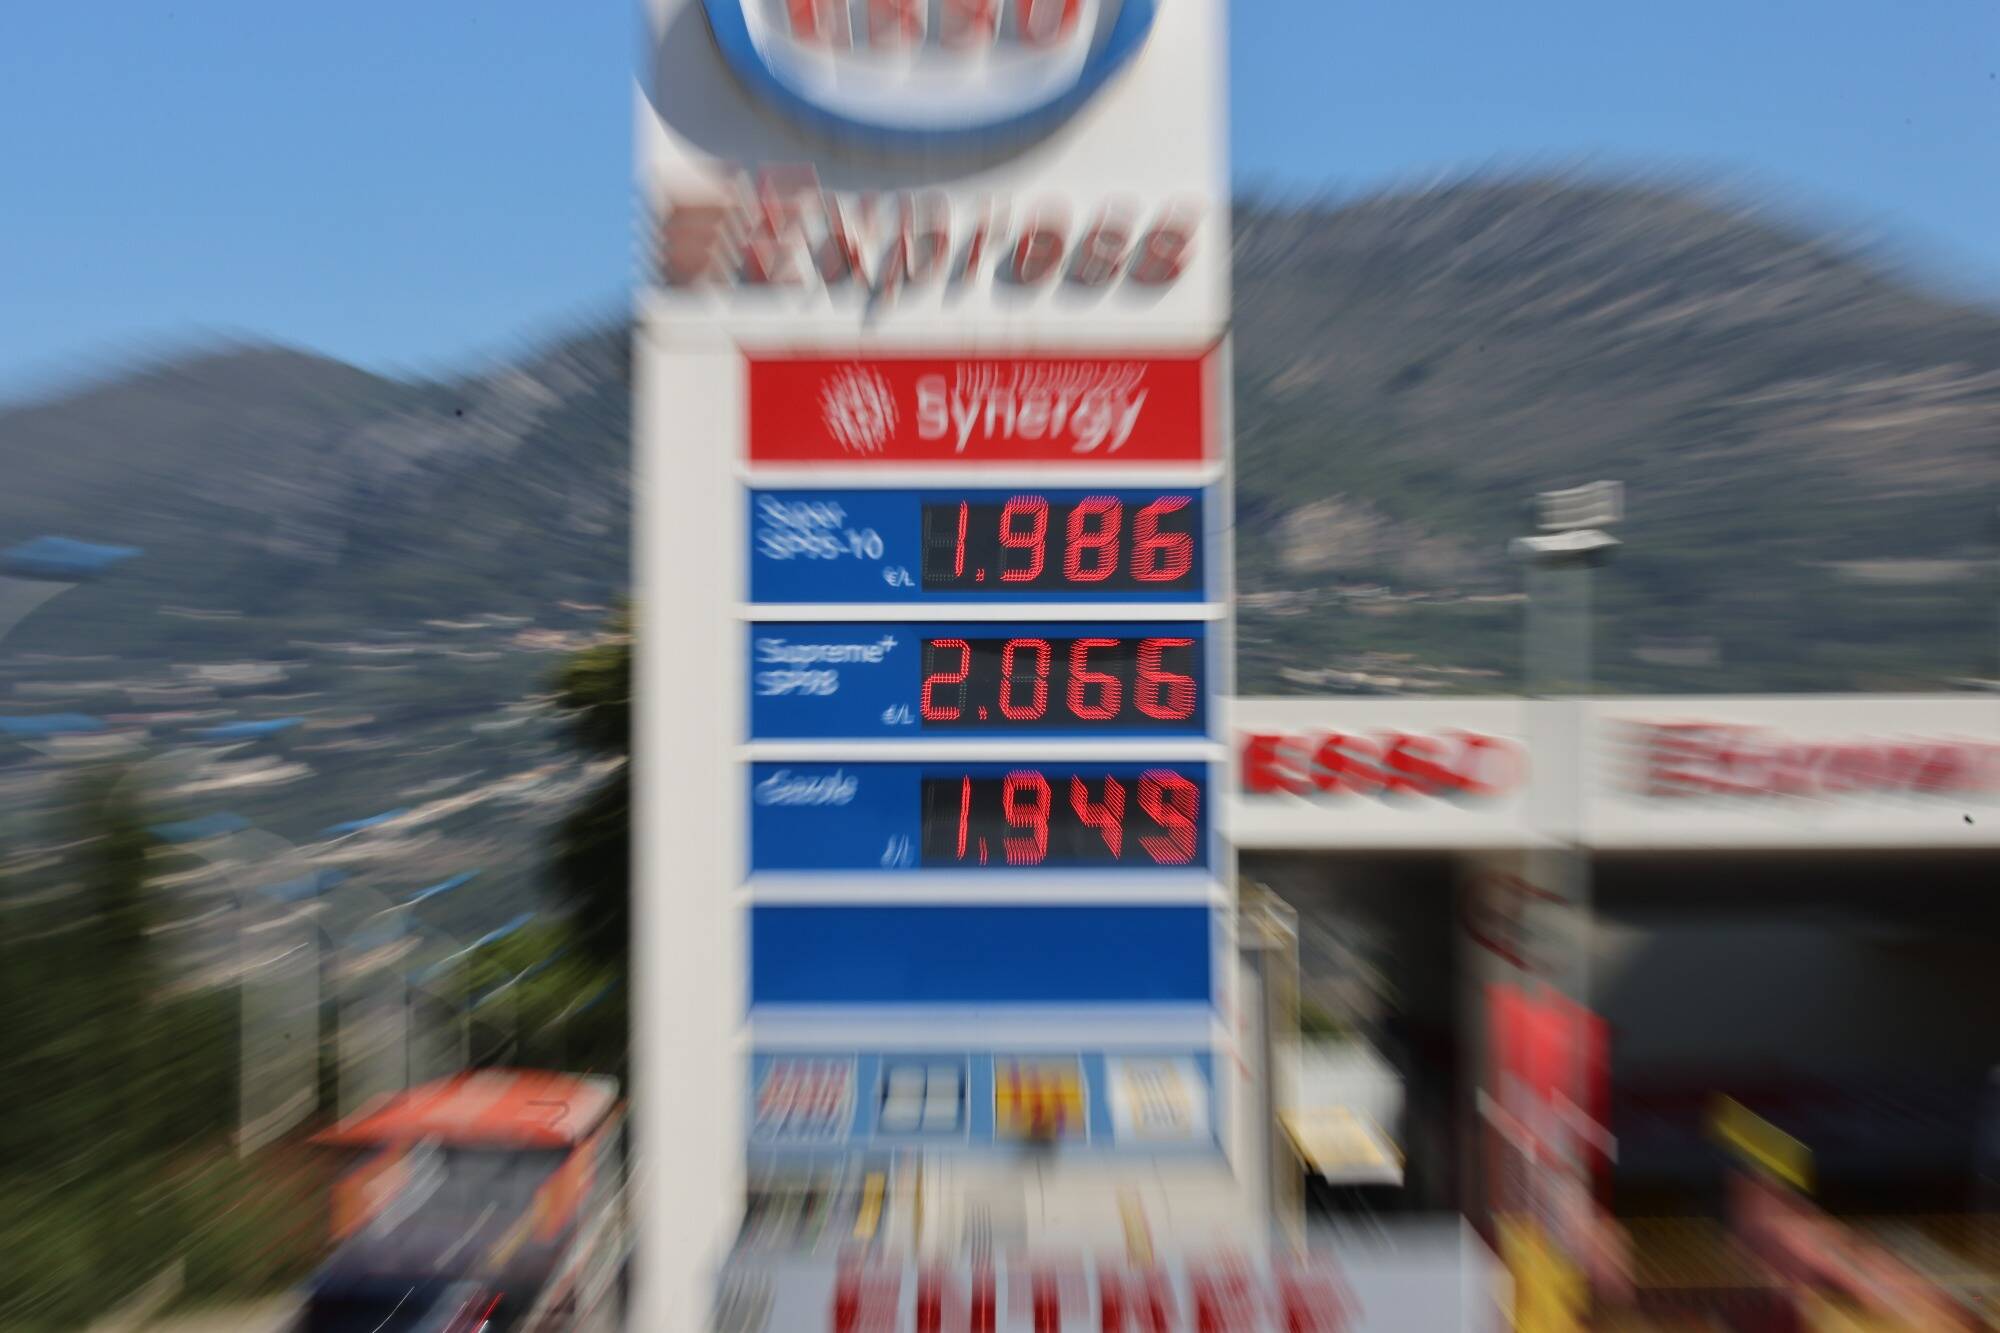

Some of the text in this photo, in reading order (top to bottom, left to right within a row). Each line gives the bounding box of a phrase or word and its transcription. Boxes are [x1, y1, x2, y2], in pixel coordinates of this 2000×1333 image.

[916, 374, 1149, 453] Synergy
[952, 495, 1193, 582] 1.986
[920, 638, 1197, 720] 2.066
[956, 769, 1199, 866] 1.949
